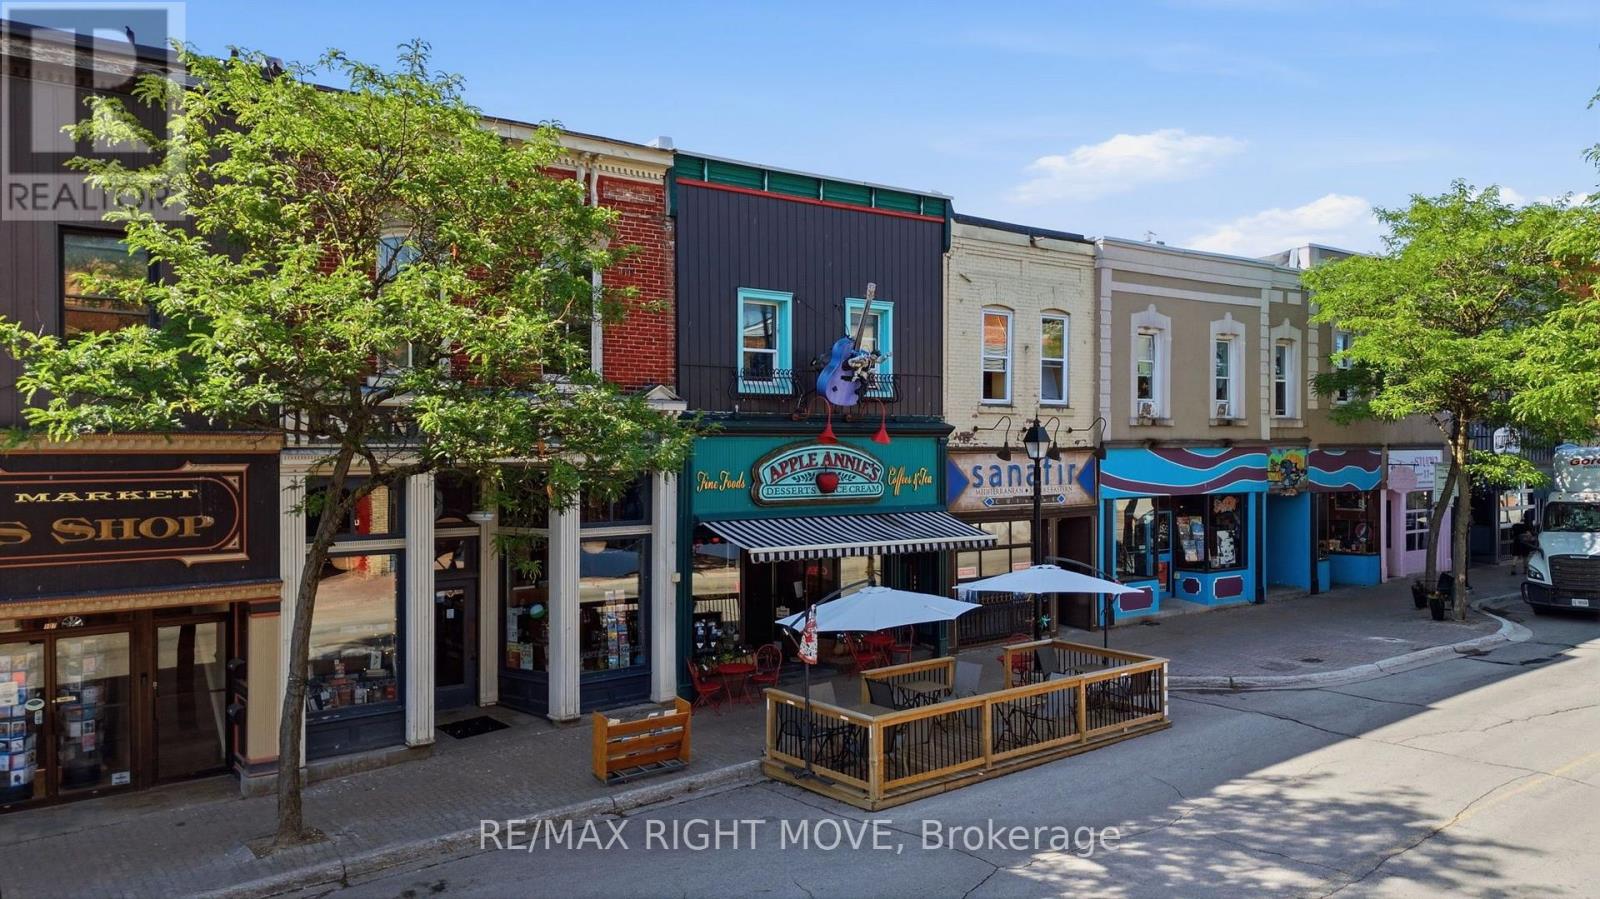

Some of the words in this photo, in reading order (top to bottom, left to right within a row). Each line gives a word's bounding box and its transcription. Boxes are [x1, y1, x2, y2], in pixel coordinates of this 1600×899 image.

[770, 452, 819, 482] APPLE
[821, 451, 881, 481] ANNIE'S
[697, 471, 718, 492] Fine
[719, 470, 745, 491] Foods
[766, 486, 816, 496] DESSERTS
[848, 485, 880, 494] CREAM
[14, 488, 199, 504] MARKET
[51, 515, 215, 544] SHOP
